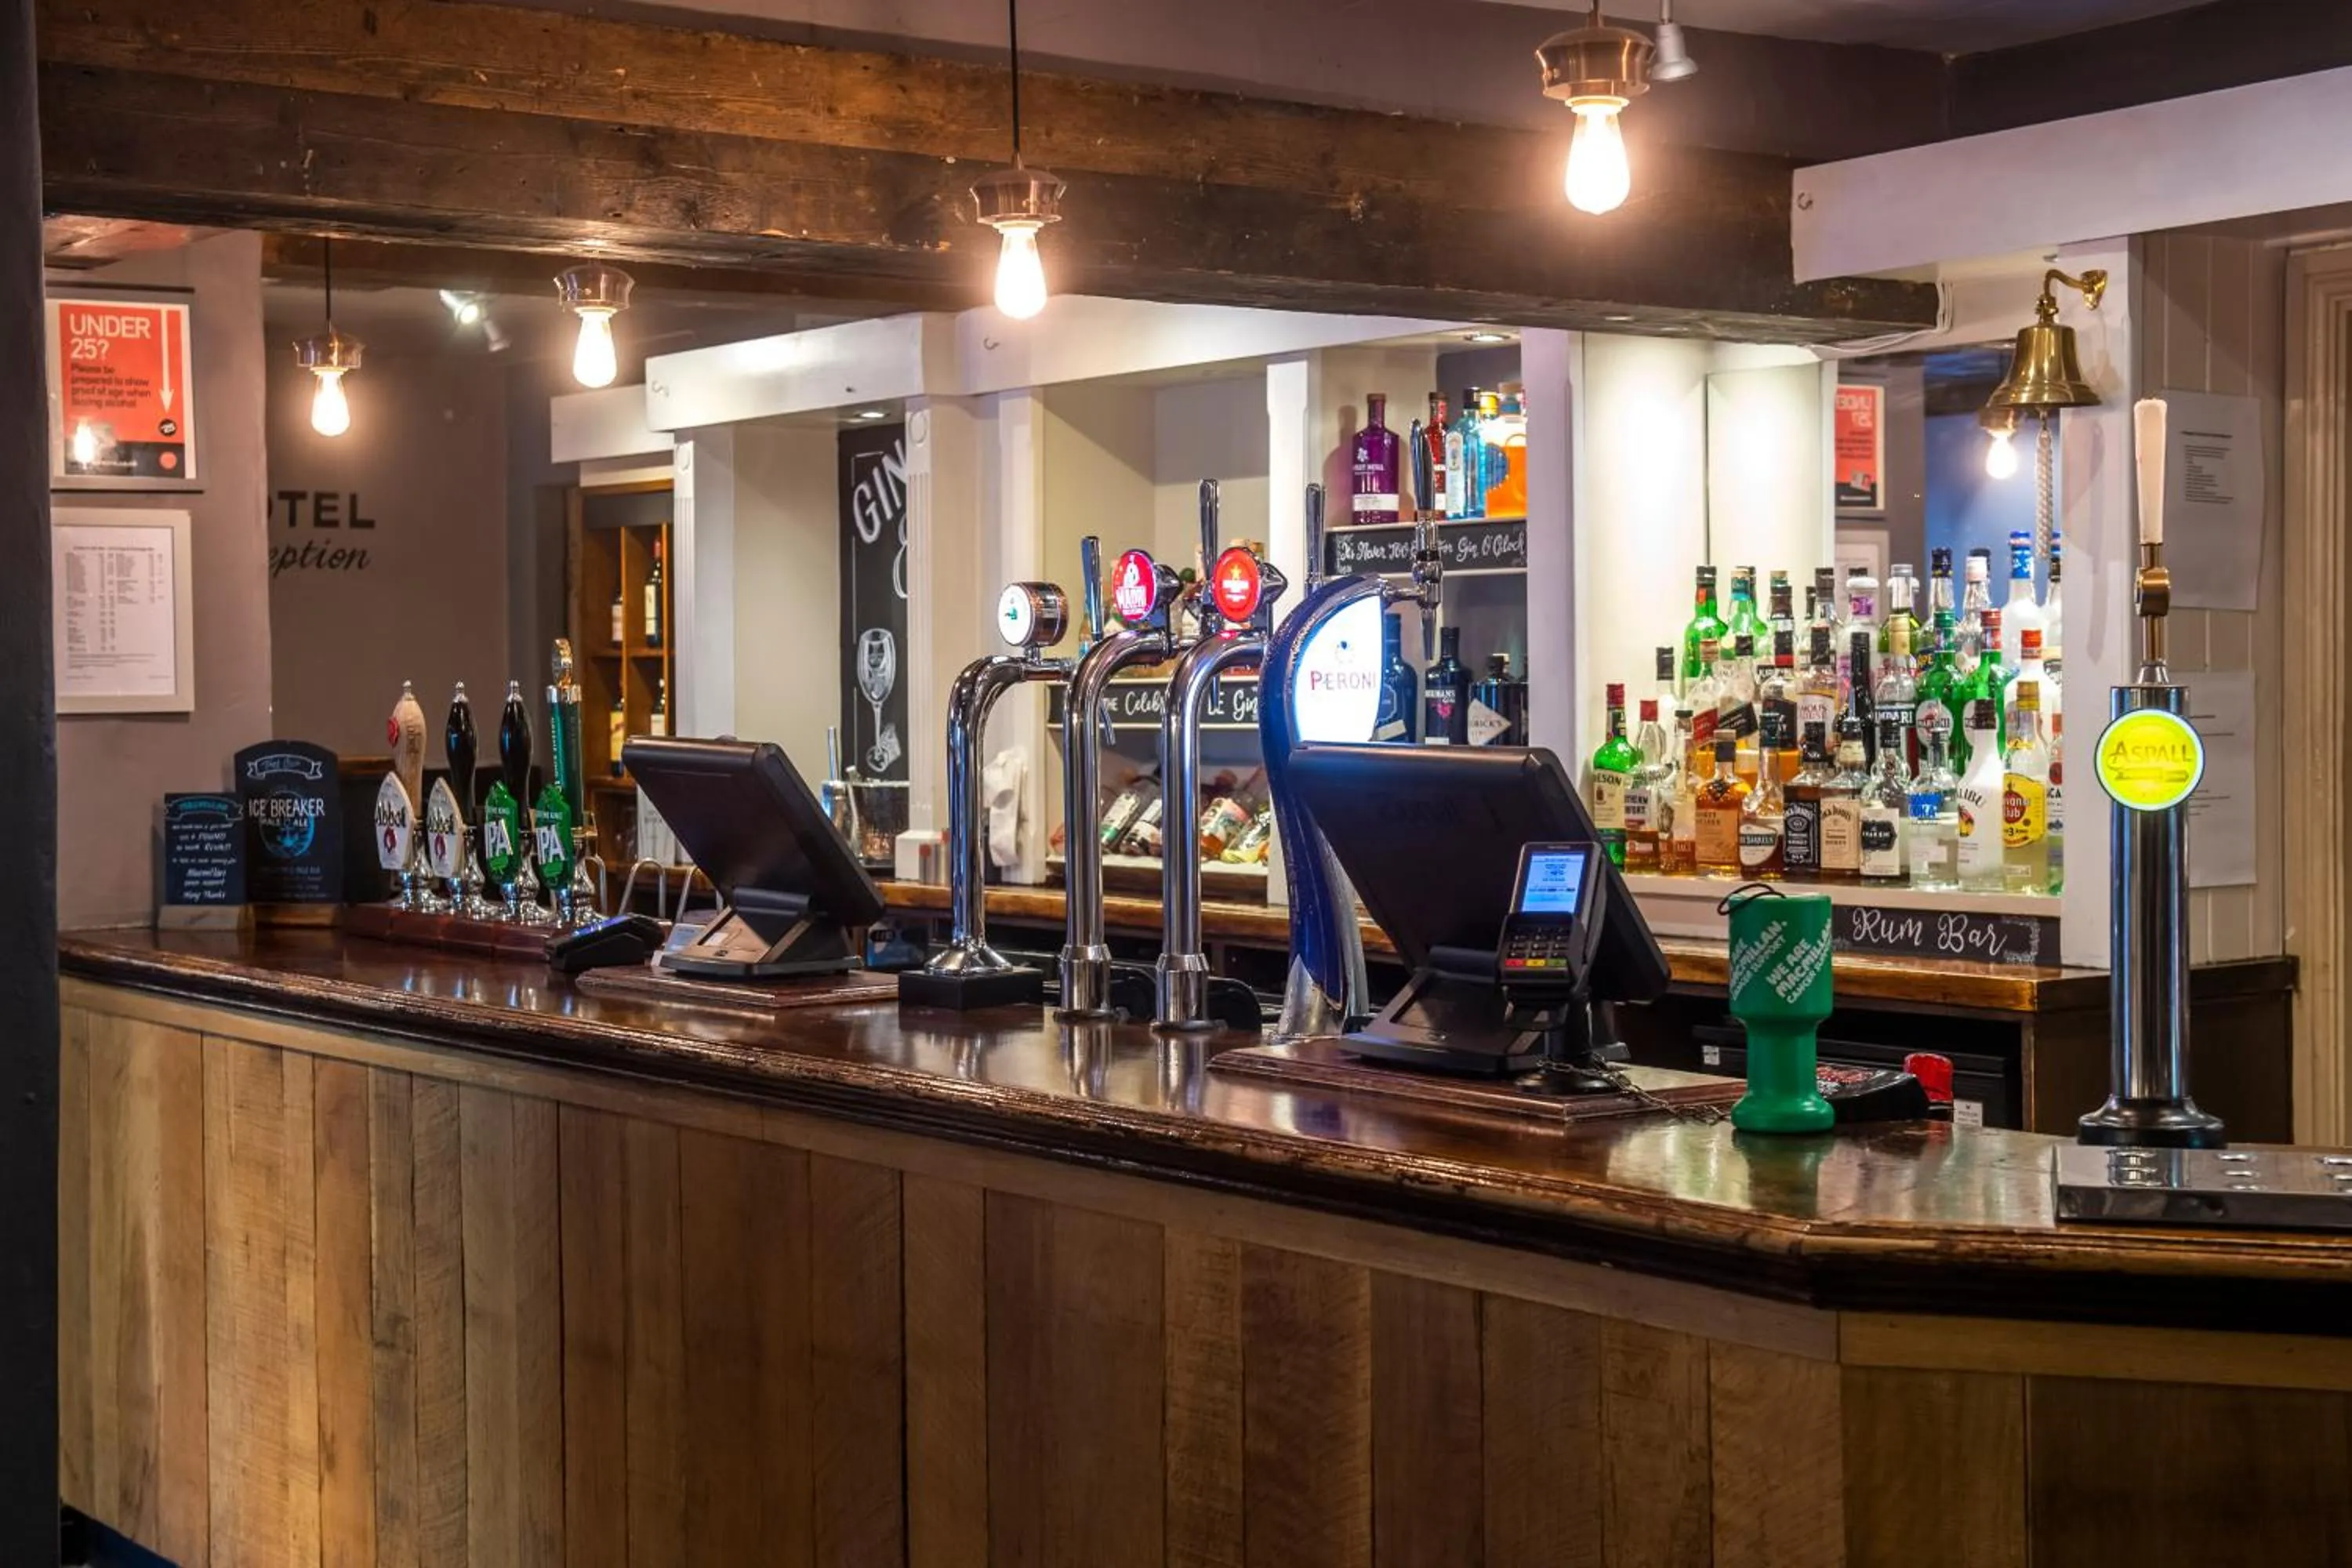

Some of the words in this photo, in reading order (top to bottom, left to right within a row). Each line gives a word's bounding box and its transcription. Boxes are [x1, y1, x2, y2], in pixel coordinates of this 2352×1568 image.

[69, 314, 151, 339] UNDER
[71, 338, 110, 361] 25?
[268, 490, 376, 529] TEL
[1310, 670, 1377, 691] PERONI
[2107, 740, 2193, 764] ASPALL
[249, 798, 267, 817] ICE
[270, 797, 326, 818] BREAKER
[293, 818, 309, 827] ALE
[484, 818, 514, 859] IPA
[535, 824, 565, 866] IPA
[1853, 907, 1923, 947] Rum
[1937, 913, 2008, 956] Bar
[1766, 963, 1789, 985] WE
[1786, 938, 1812, 967] ARE
